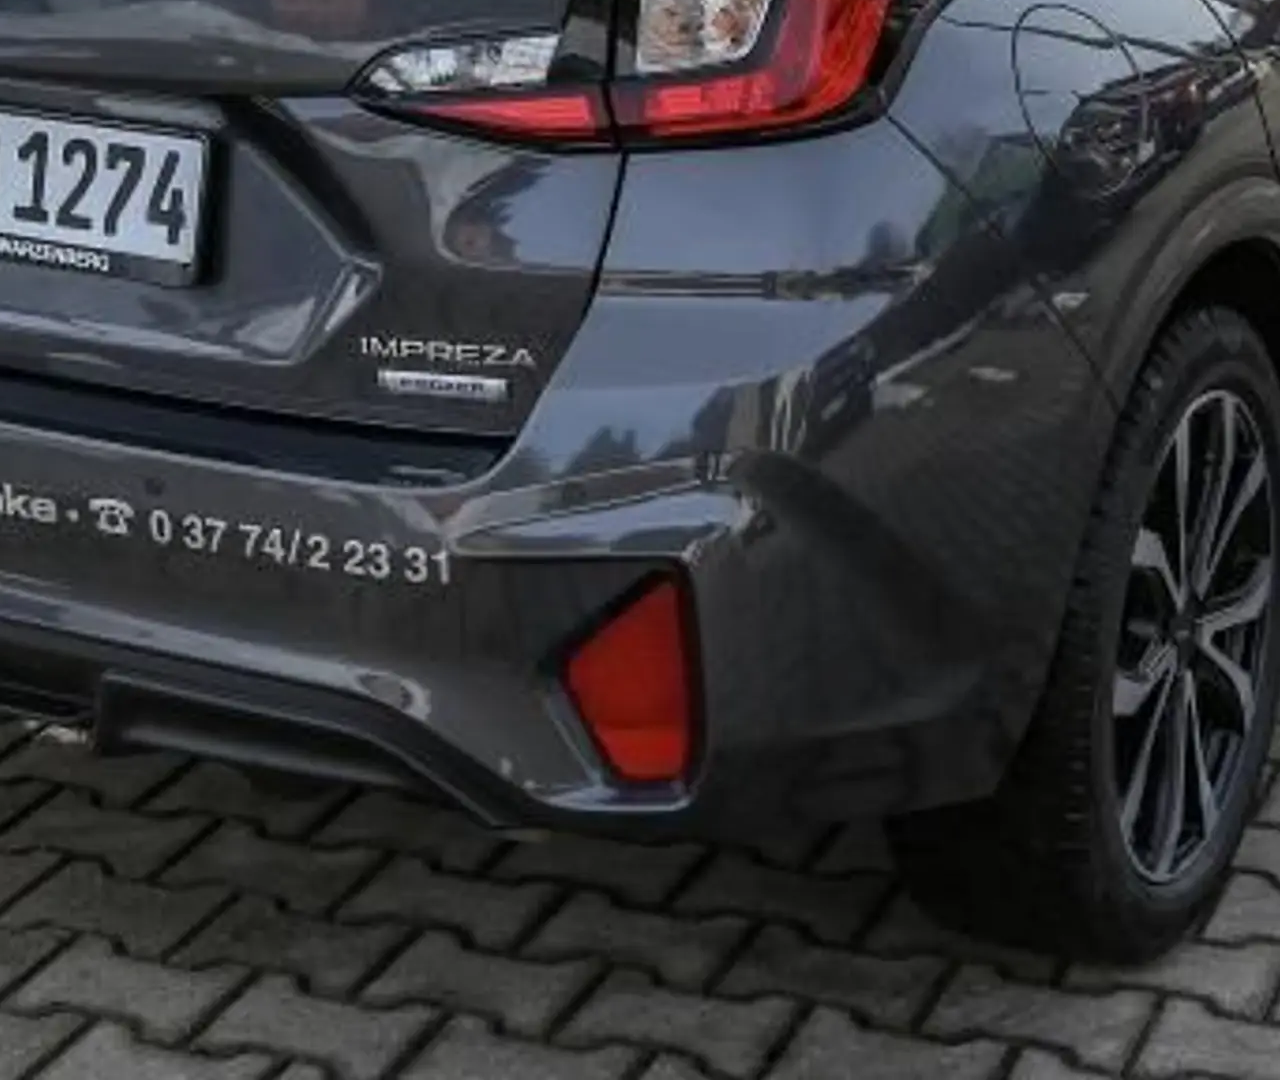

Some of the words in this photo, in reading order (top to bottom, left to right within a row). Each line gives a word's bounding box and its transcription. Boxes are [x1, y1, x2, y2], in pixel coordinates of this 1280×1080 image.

[13, 130, 187, 244] 1274
[360, 336, 537, 369] IMPREZA
[149, 509, 172, 545] 0
[182, 518, 227, 553] 37
[343, 539, 391, 580] 23
[404, 546, 452, 586] 31
